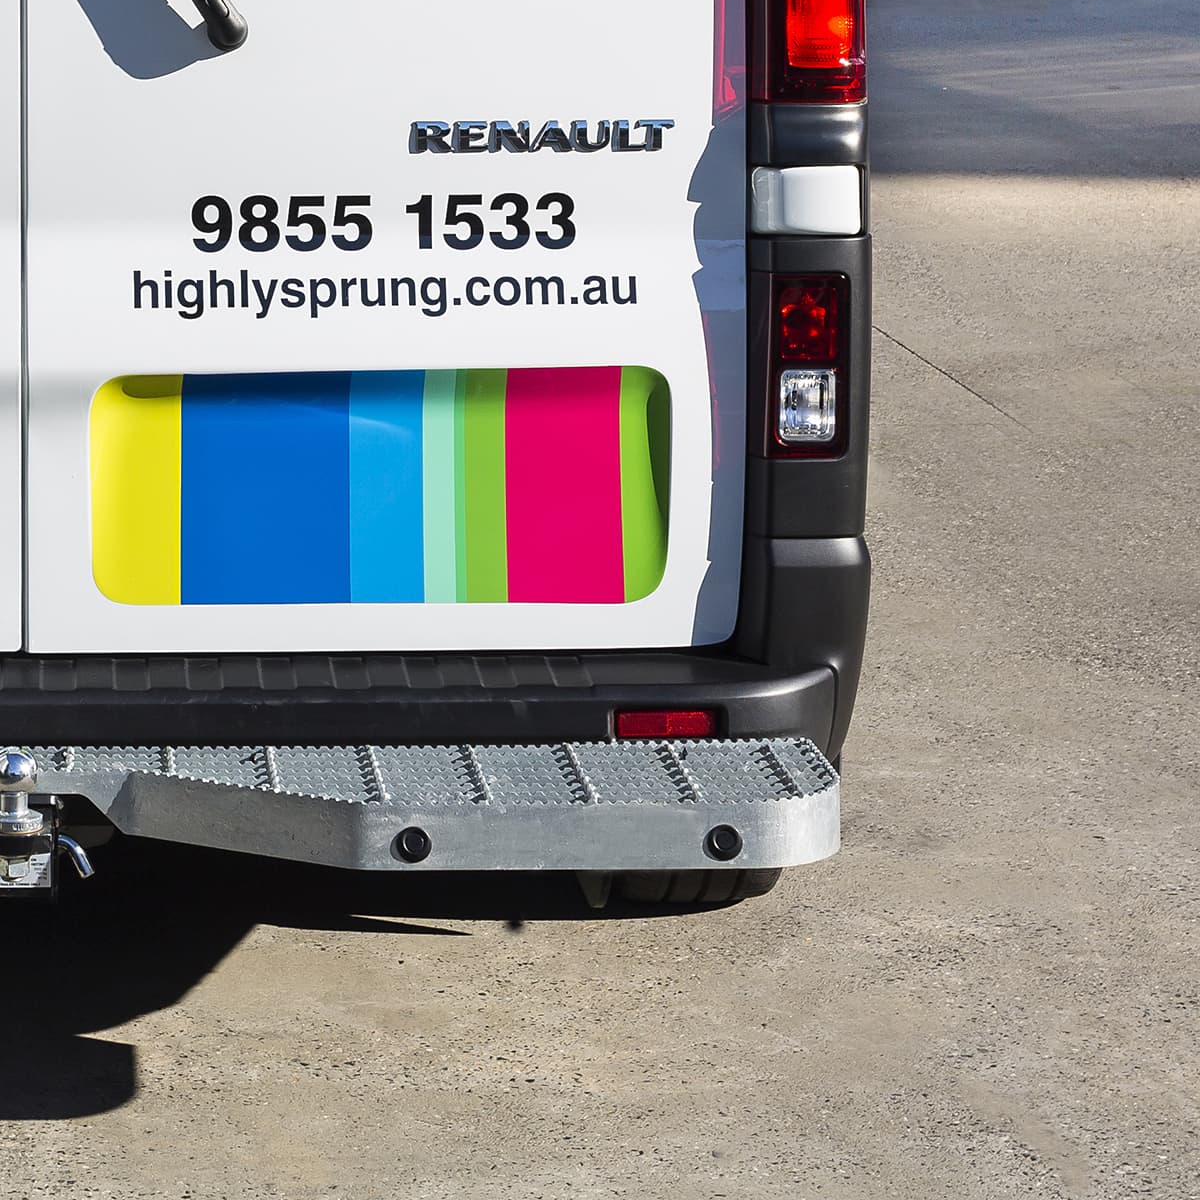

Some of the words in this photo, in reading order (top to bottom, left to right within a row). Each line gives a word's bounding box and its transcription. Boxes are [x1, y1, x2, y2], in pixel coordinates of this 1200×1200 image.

[410, 120, 676, 153] RENAULT
[191, 194, 373, 253] 9855
[405, 192, 577, 251] 1533
[132, 269, 638, 320] highlysprung.com.au
